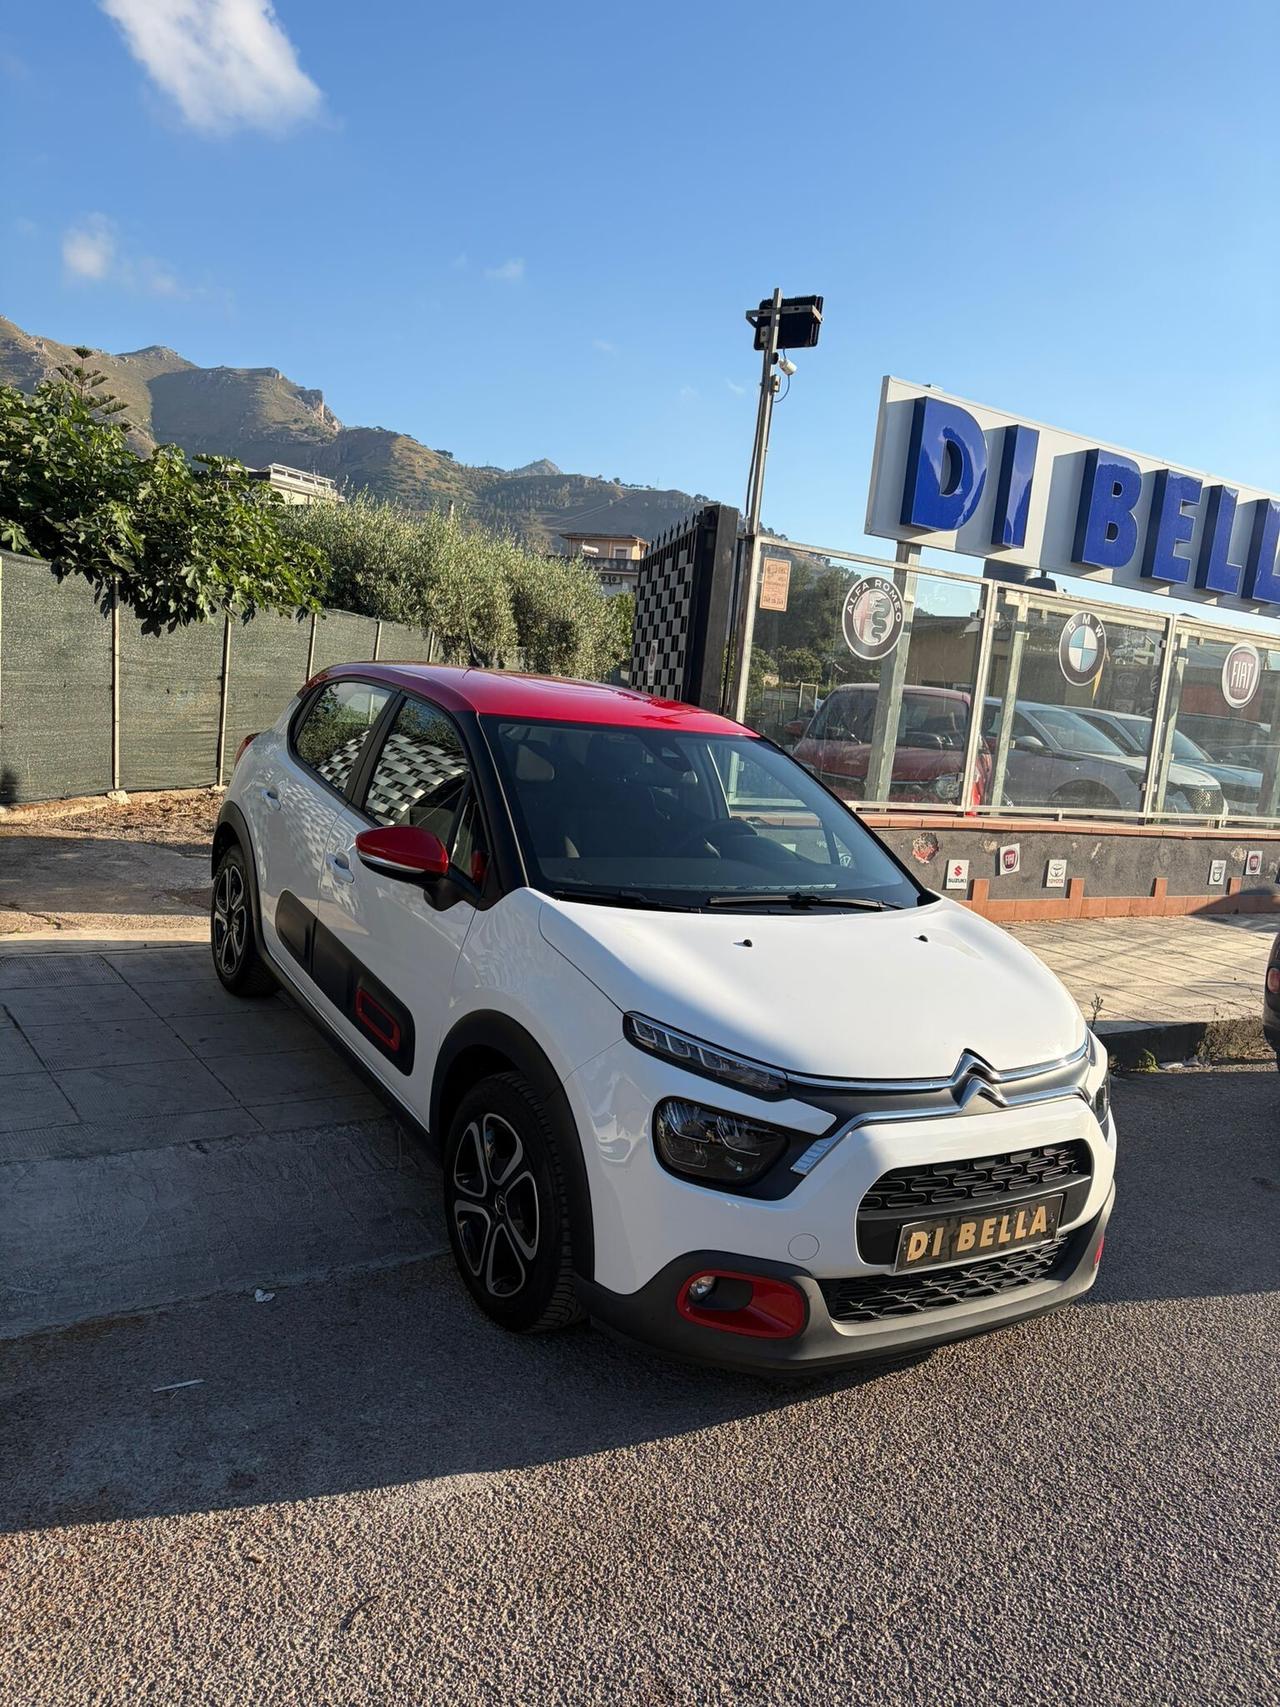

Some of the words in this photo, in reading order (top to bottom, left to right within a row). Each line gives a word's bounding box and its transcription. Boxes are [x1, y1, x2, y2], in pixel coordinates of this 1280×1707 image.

[900, 395, 1040, 550] DI
[847, 582, 870, 615] ALFA
[874, 580, 902, 622] ROMEO
[1067, 613, 1104, 638] BMW
[1230, 661, 1254, 690] FIAT
[906, 1227, 945, 1262] DI
[957, 1205, 1047, 1252] BELLA
